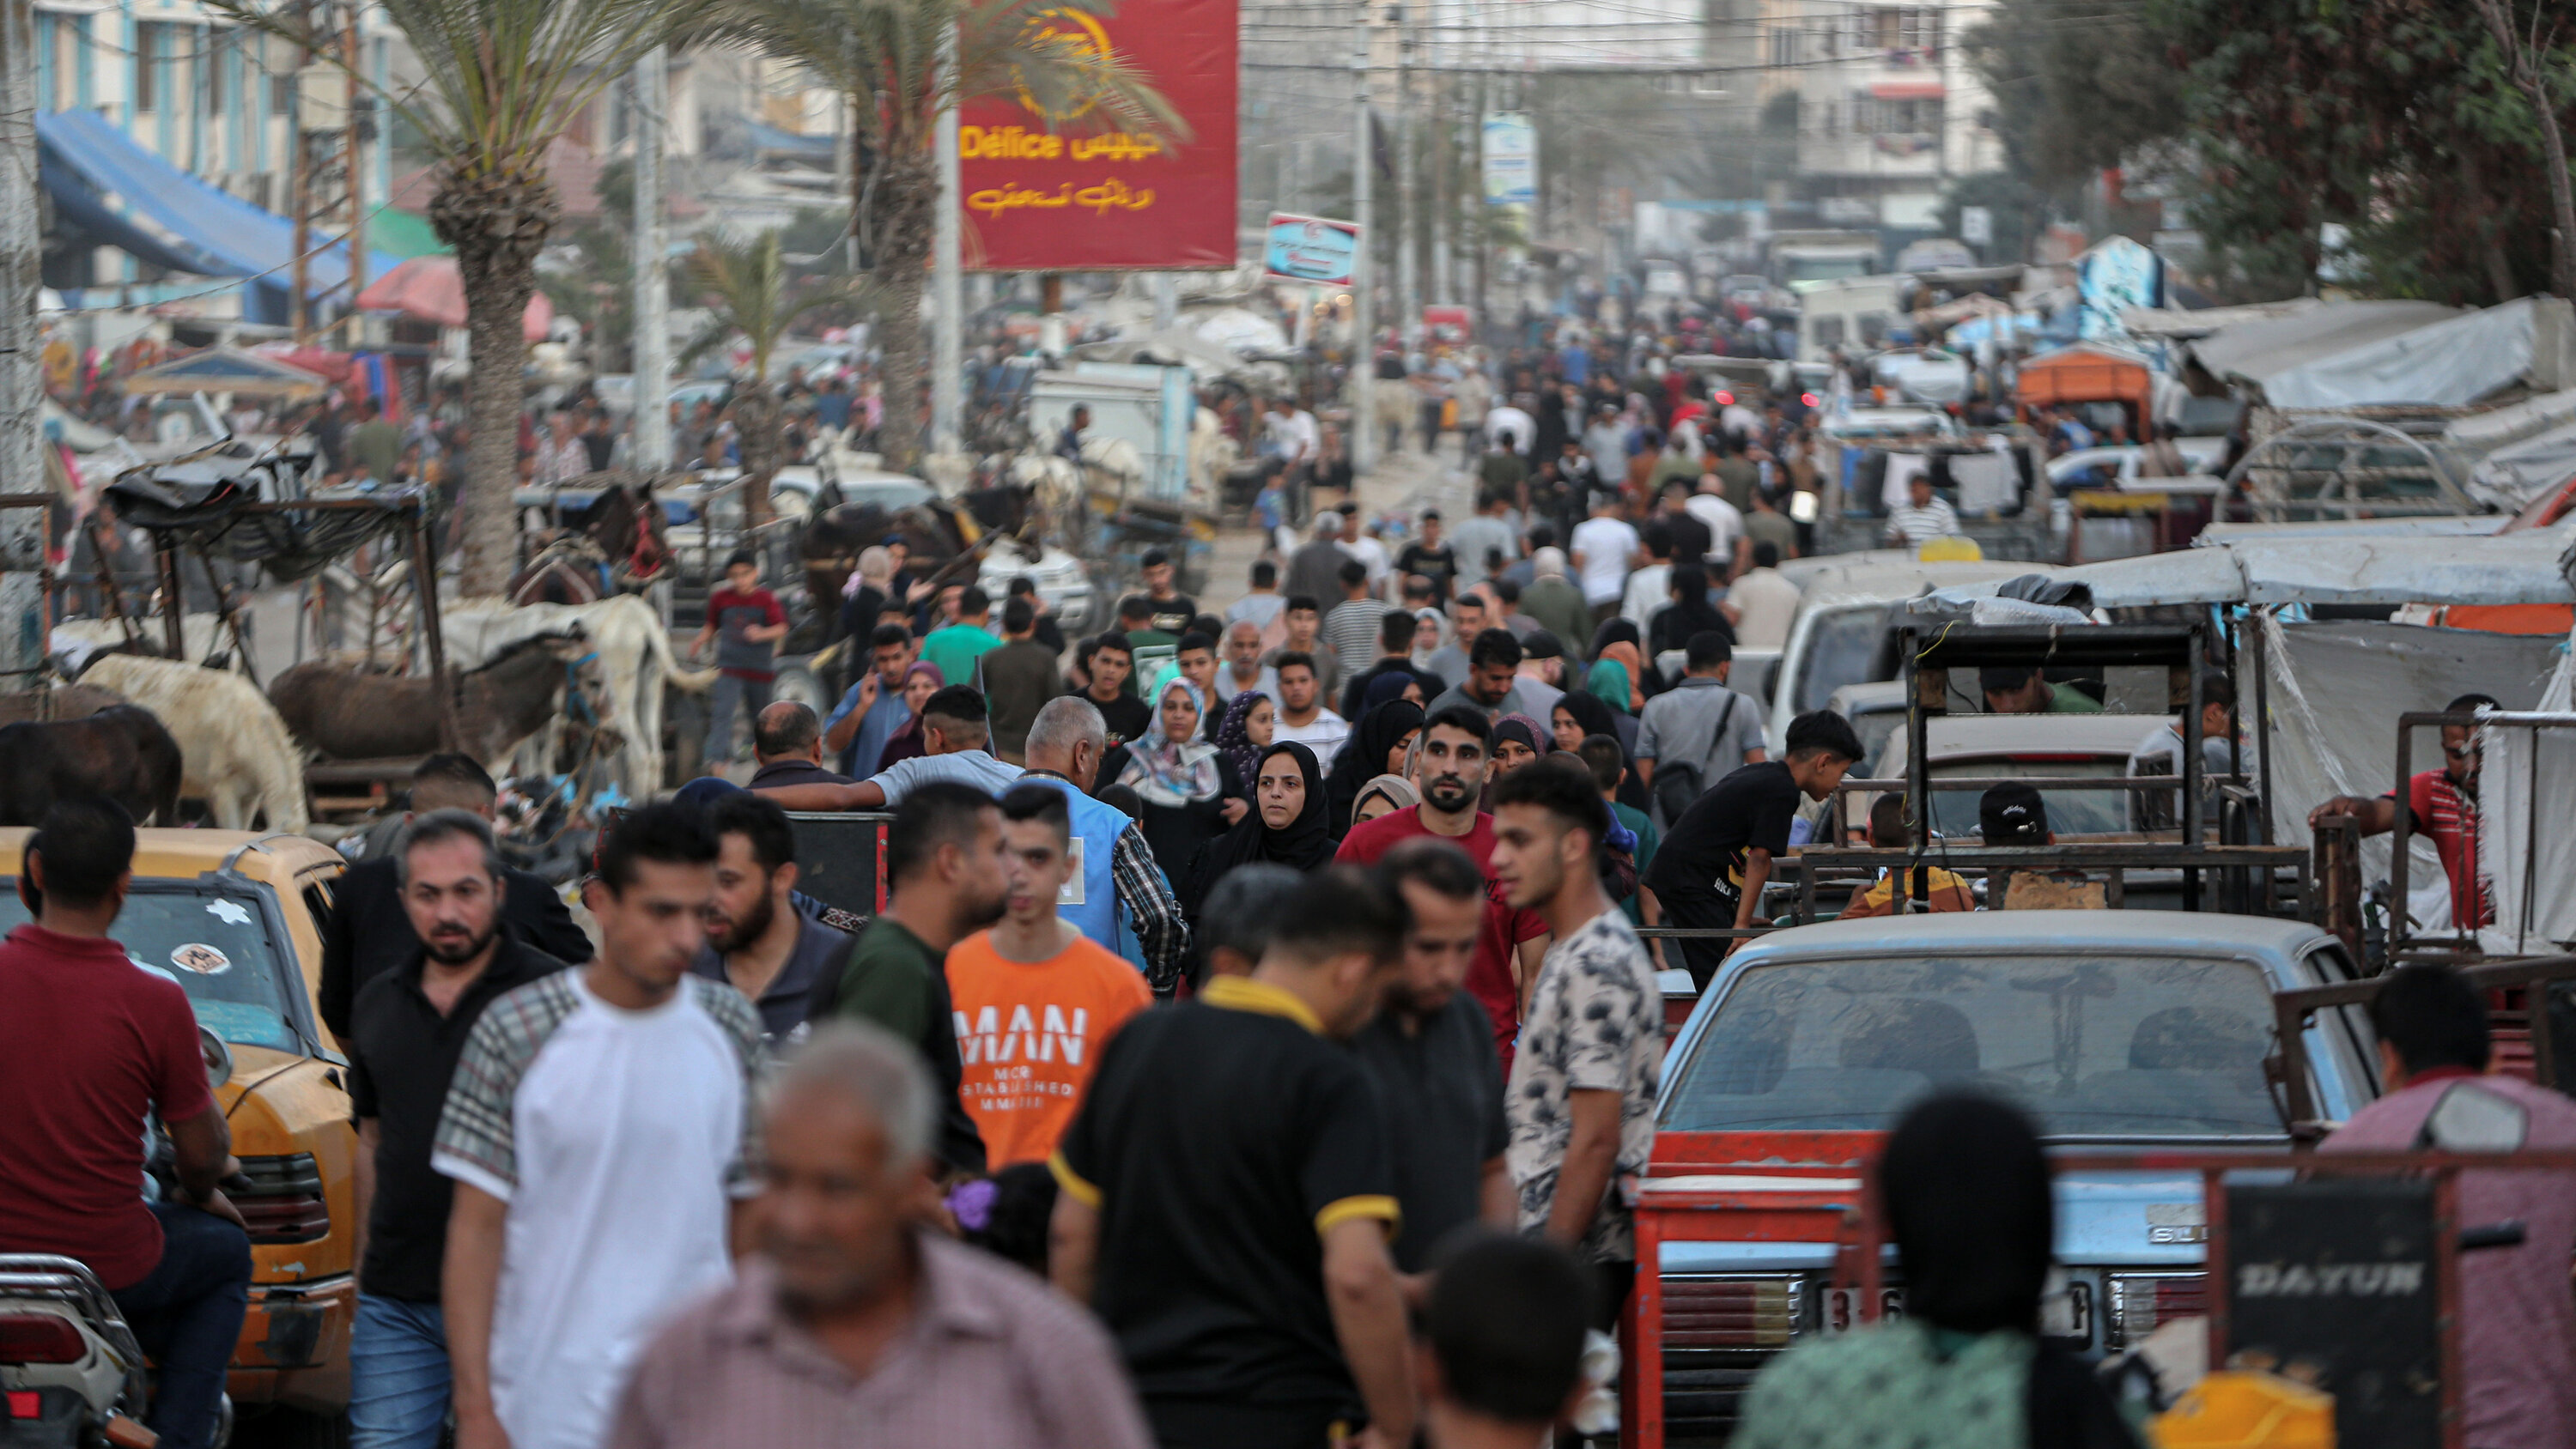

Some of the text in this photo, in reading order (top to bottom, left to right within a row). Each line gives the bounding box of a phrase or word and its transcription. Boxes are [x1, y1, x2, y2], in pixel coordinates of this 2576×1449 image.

[959, 125, 1064, 159] Délice
[962, 1080, 1076, 1097] STABLISHED
[2238, 1262, 2425, 1296] DAYUN
